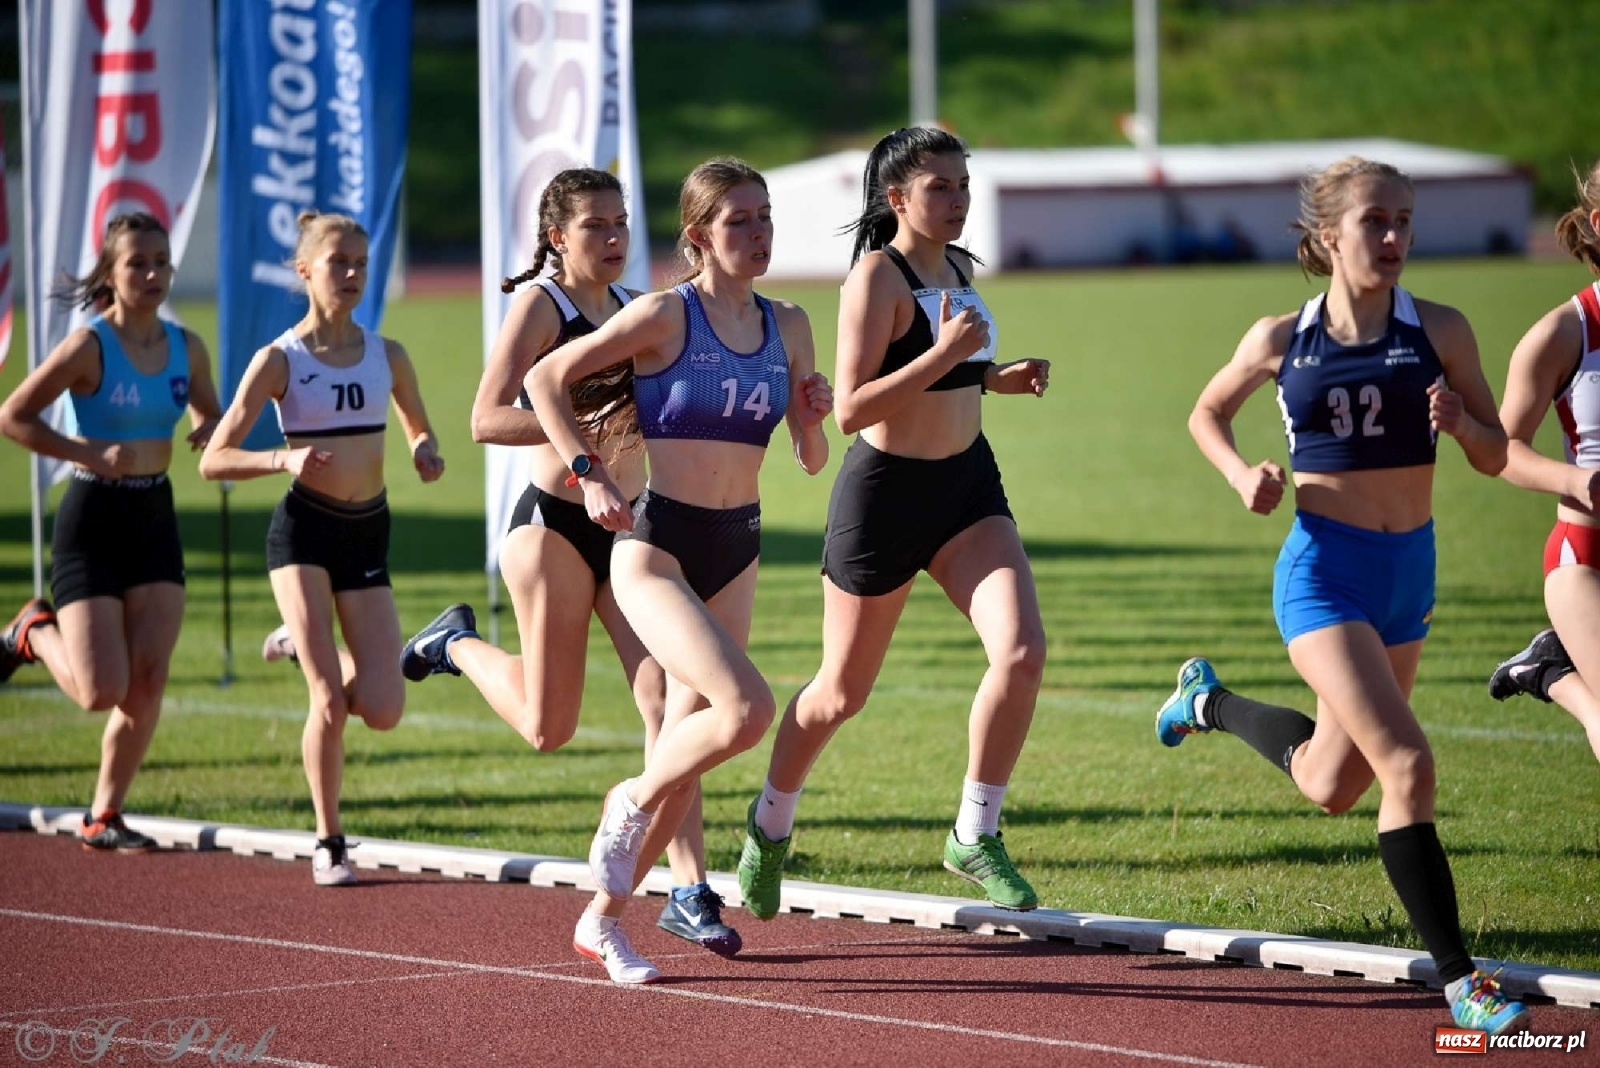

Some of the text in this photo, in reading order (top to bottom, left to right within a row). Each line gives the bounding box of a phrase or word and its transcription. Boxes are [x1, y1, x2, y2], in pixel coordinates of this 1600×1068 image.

[251, 0, 317, 288] lekkoa
[691, 353, 721, 363] MKS
[109, 381, 140, 408] 44
[331, 382, 365, 412] 70
[721, 378, 771, 421] 14
[1327, 384, 1384, 437] 32
